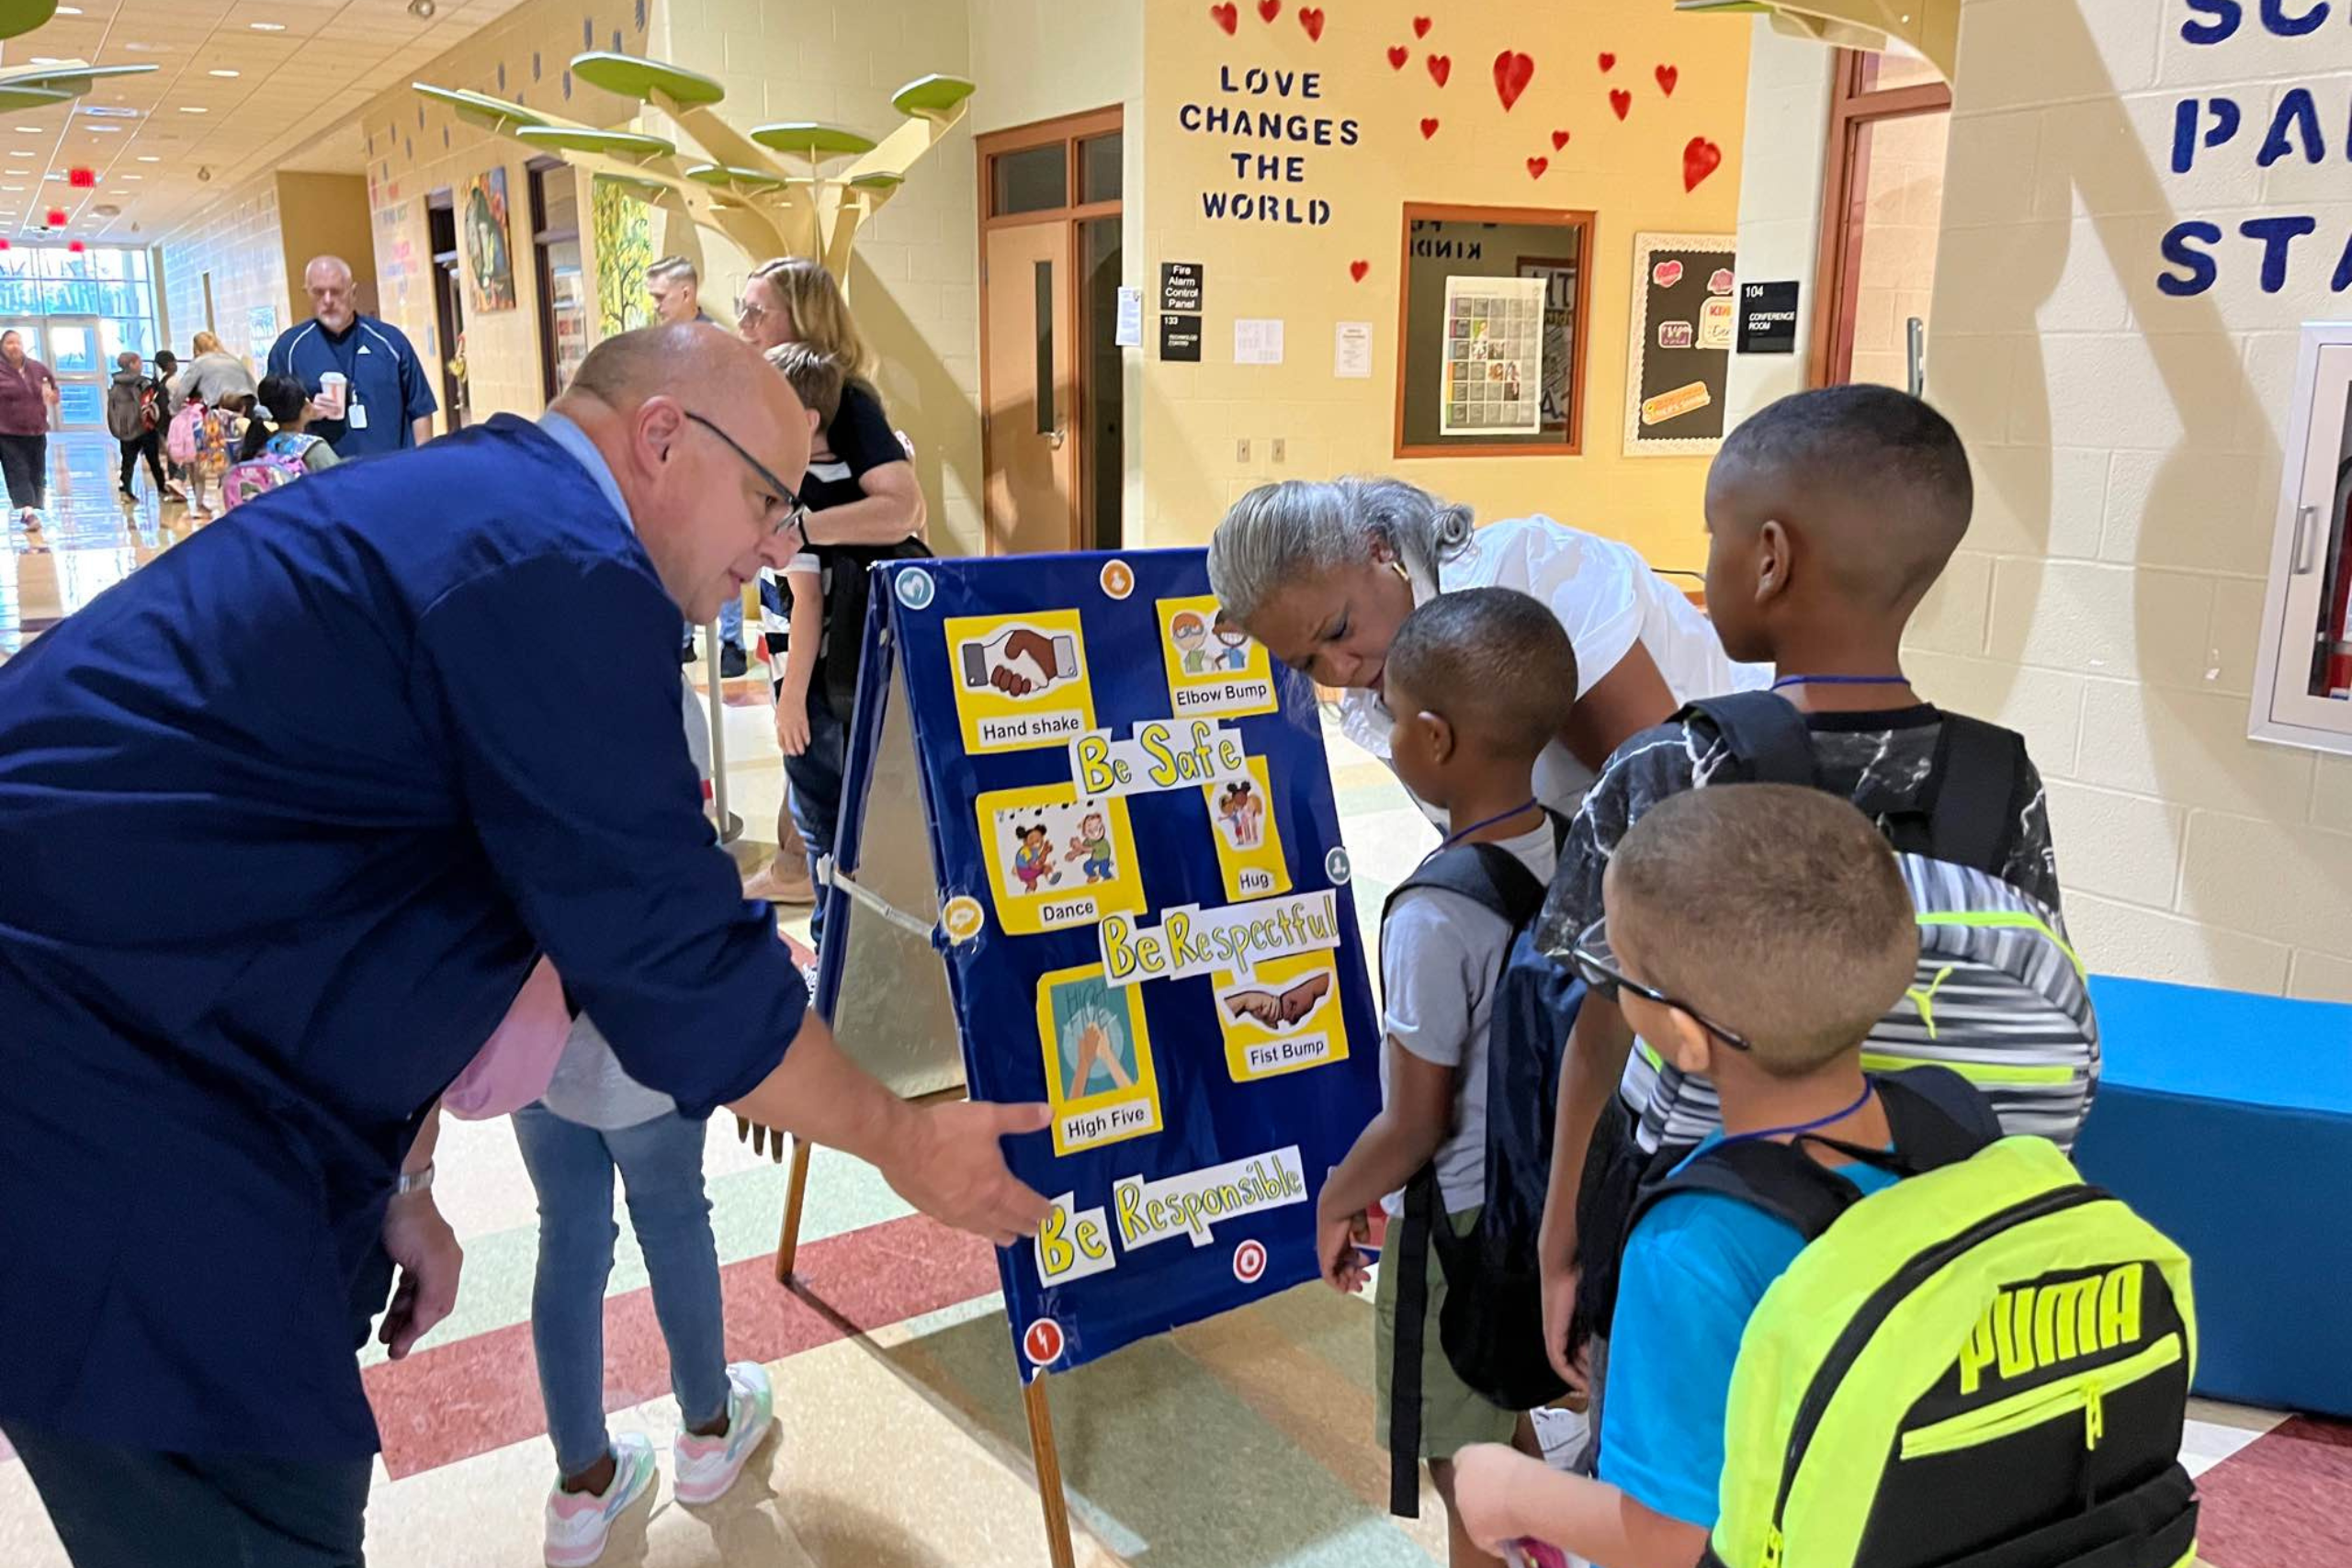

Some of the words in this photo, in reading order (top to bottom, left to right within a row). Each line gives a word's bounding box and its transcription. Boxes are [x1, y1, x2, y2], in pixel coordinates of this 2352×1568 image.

[1221, 65, 1320, 98] LOVE
[1180, 105, 1359, 145] CHANGES
[2171, 88, 2352, 174] PA
[1231, 152, 1305, 182] THE
[1202, 192, 1330, 225] WORLD
[1169, 276, 1196, 287] Alarm
[1173, 265, 1192, 275] Fire
[1165, 288, 1199, 298] Control
[1169, 299, 1195, 309] Panel
[1746, 286, 1763, 299] 104
[1747, 321, 1771, 332] ROOM
[1748, 311, 1795, 321] CONFERENCE
[1177, 690, 1221, 705] Elbow
[1225, 684, 1267, 699] Bump
[983, 721, 1027, 739] Hand
[1032, 716, 1080, 734] shake
[1077, 736, 1132, 794] Be
[1140, 722, 1241, 787] Safe
[1240, 874, 1270, 890] Hug
[1043, 899, 1094, 921] Dance
[1102, 915, 1165, 978] Be
[1164, 895, 1339, 975] Respectful
[1250, 1047, 1278, 1066] Fist
[1283, 1040, 1324, 1059] Bump
[1069, 1115, 1106, 1139] High
[1112, 1108, 1144, 1127] Five
[1036, 1204, 1108, 1278] Be
[1114, 1155, 1304, 1245] Responsible
[1960, 1262, 2143, 1395] PUMA
